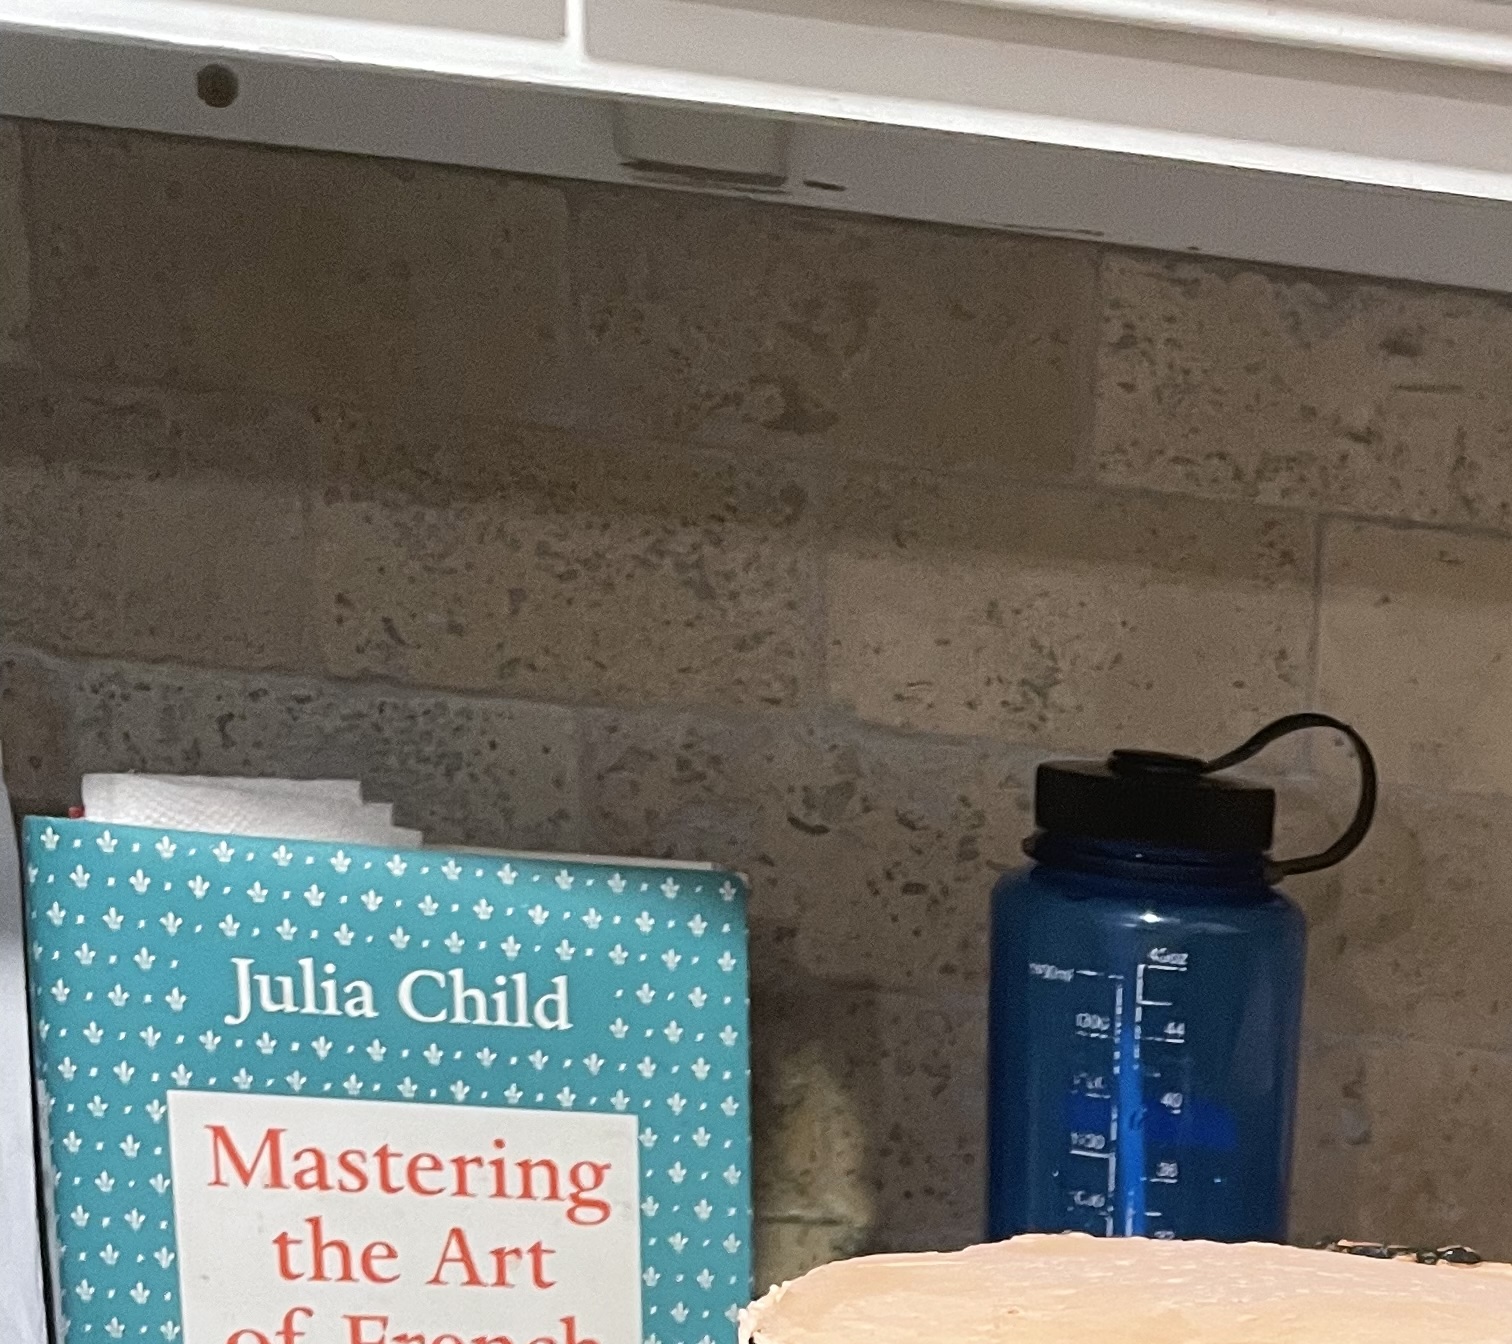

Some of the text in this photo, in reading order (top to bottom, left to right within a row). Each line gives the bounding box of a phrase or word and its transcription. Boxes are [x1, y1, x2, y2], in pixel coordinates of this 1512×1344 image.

[225, 957, 574, 1031] Julia Child
[205, 1124, 612, 1226] Mastering
[273, 1215, 556, 1289] the Art
